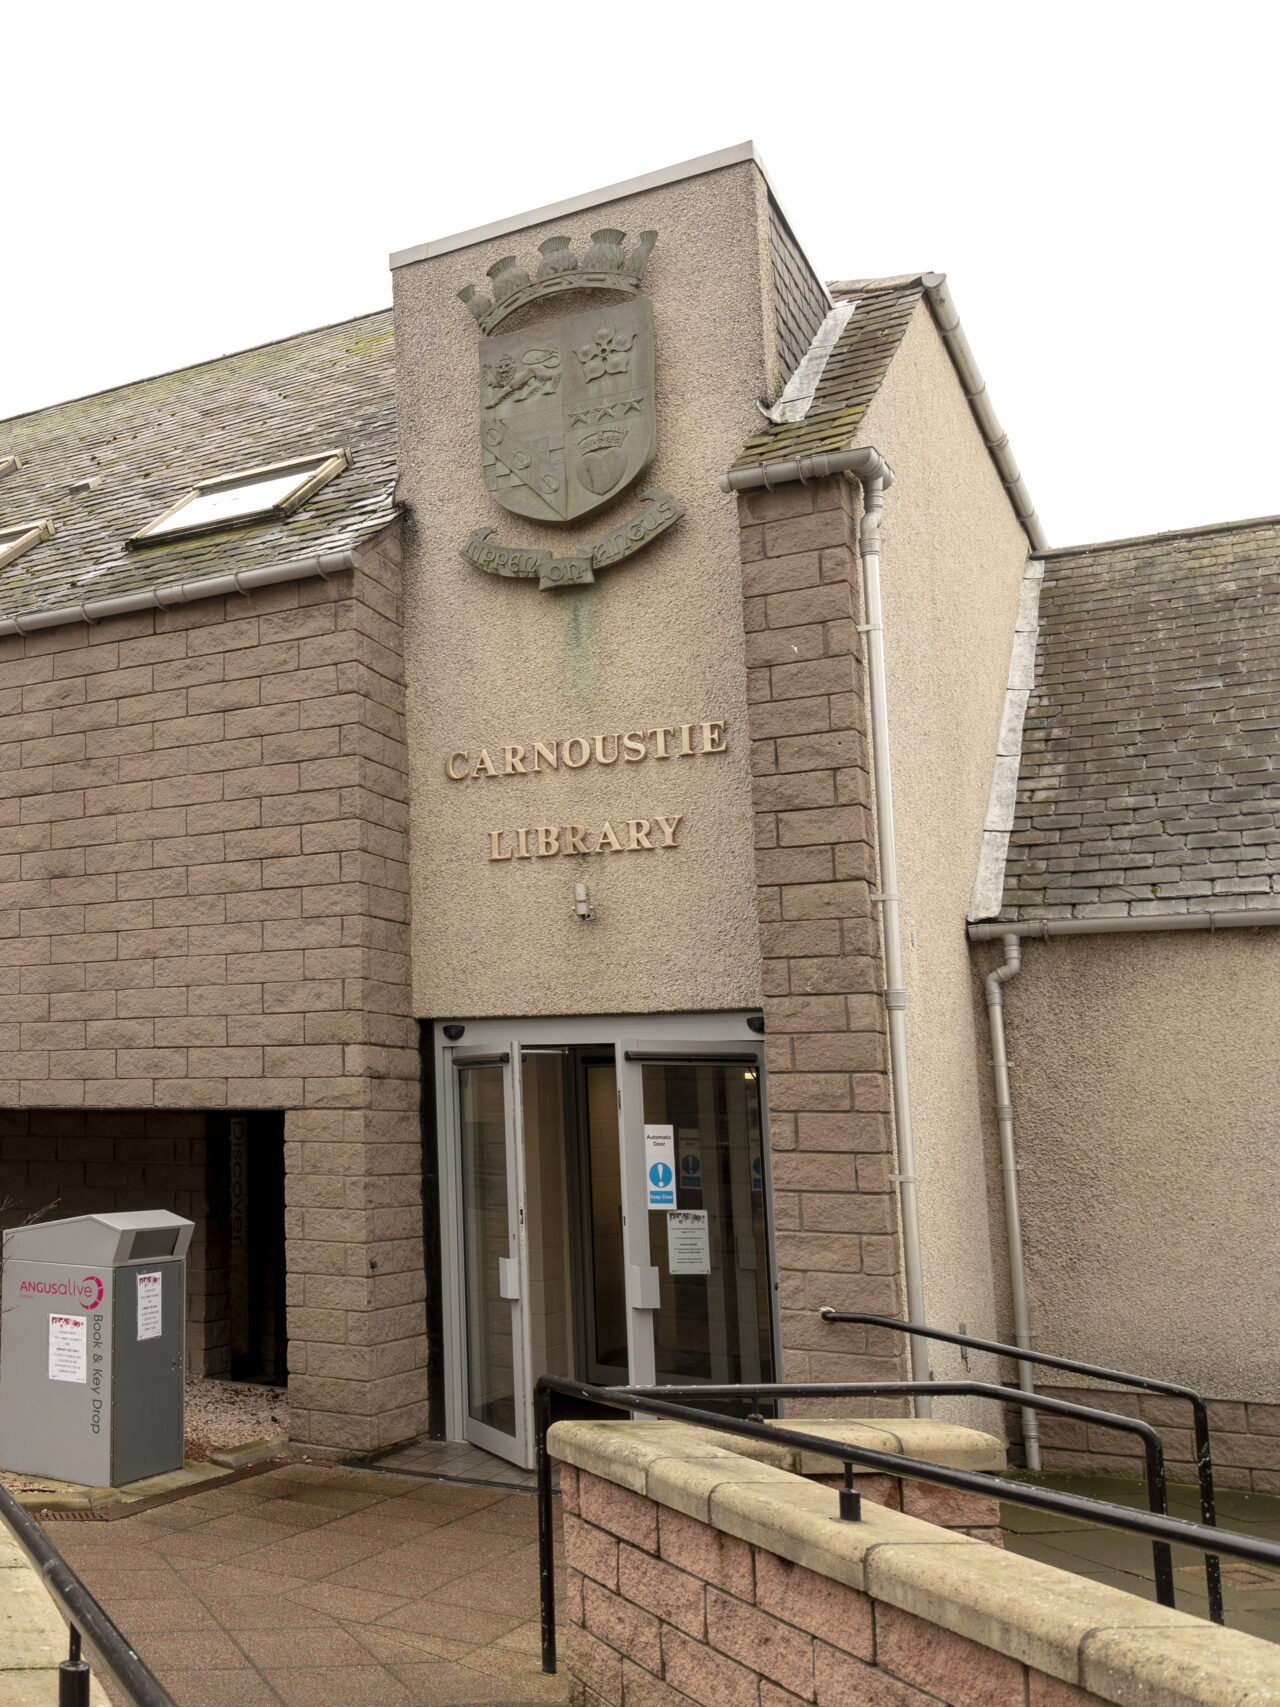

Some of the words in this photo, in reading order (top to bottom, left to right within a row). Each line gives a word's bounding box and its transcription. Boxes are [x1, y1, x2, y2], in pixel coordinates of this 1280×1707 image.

[445, 720, 727, 780] CARNOUSTIE
[488, 815, 683, 861] LIBRARY
[93, 1314, 104, 1348] Book
[92, 1353, 103, 1364] &
[90, 1368, 103, 1395] Key
[90, 1399, 103, 1434] Drop
